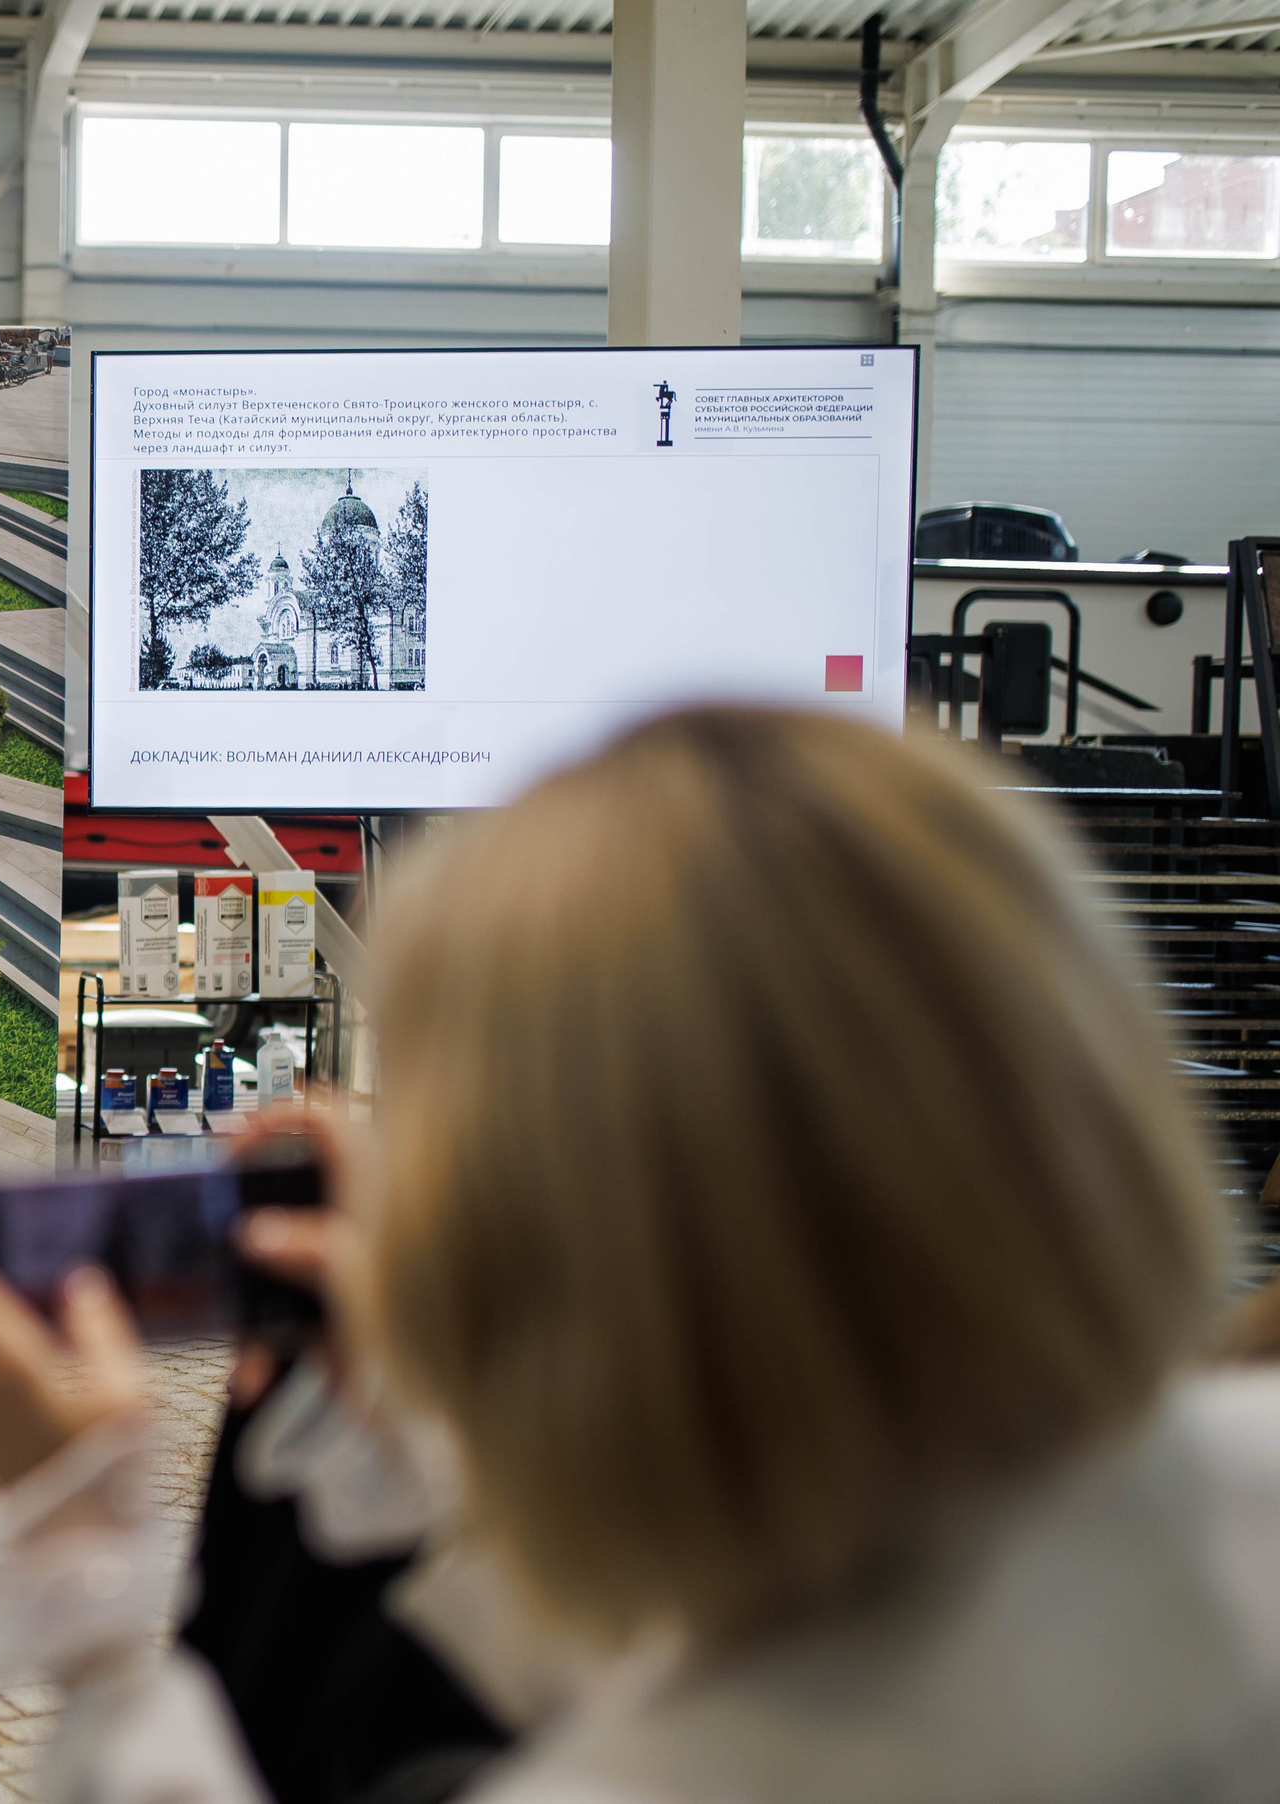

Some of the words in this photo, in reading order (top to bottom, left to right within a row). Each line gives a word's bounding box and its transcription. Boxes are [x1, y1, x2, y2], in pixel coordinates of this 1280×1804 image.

[134, 387, 169, 398] Город
[694, 395, 725, 403] СОВЕТ
[726, 395, 770, 403] ГЛАВНЫХ
[772, 394, 844, 403] АРХИТЕКТОРОВ
[133, 401, 194, 413] Духовный
[199, 402, 237, 412] силуэт
[242, 400, 339, 412] Верхтеченского
[344, 399, 447, 411] Свято-Троицкого
[513, 400, 584, 410] монастыря,
[694, 405, 748, 413] СУБЪЕКТОВ
[750, 404, 813, 413] РОССИЙСКОЙ
[815, 404, 874, 413] ФЕДЕРАЦИИ
[134, 415, 183, 427] Верхняя
[188, 415, 214, 424] Теча
[219, 414, 286, 425] (Катайский
[292, 413, 393, 426] муниципальный
[398, 415, 433, 426] округ,
[439, 414, 506, 425] Курганская
[694, 415, 702, 423] И
[703, 414, 790, 424] МУНИЦИПАЛЬНЫХ
[792, 413, 862, 422] ОБРАЗОВАНИЙ
[134, 429, 180, 440] Методы
[197, 431, 249, 440] подходы
[253, 430, 274, 439] для
[279, 428, 371, 440] формирования
[376, 429, 426, 439] единого
[431, 429, 528, 439] архитектурного
[533, 428, 616, 439] пространства
[743, 425, 785, 434] Кузьмина
[133, 445, 168, 455] через
[172, 443, 234, 455] ландшафт
[250, 445, 291, 455] силуэт.
[130, 751, 222, 765] ДОКЛАДЧИК:
[227, 751, 297, 762] ВОЛЬМАН
[301, 751, 362, 765] ДАНИИЛ
[366, 751, 490, 765] АЛЕКСАНДРОВИЧ
